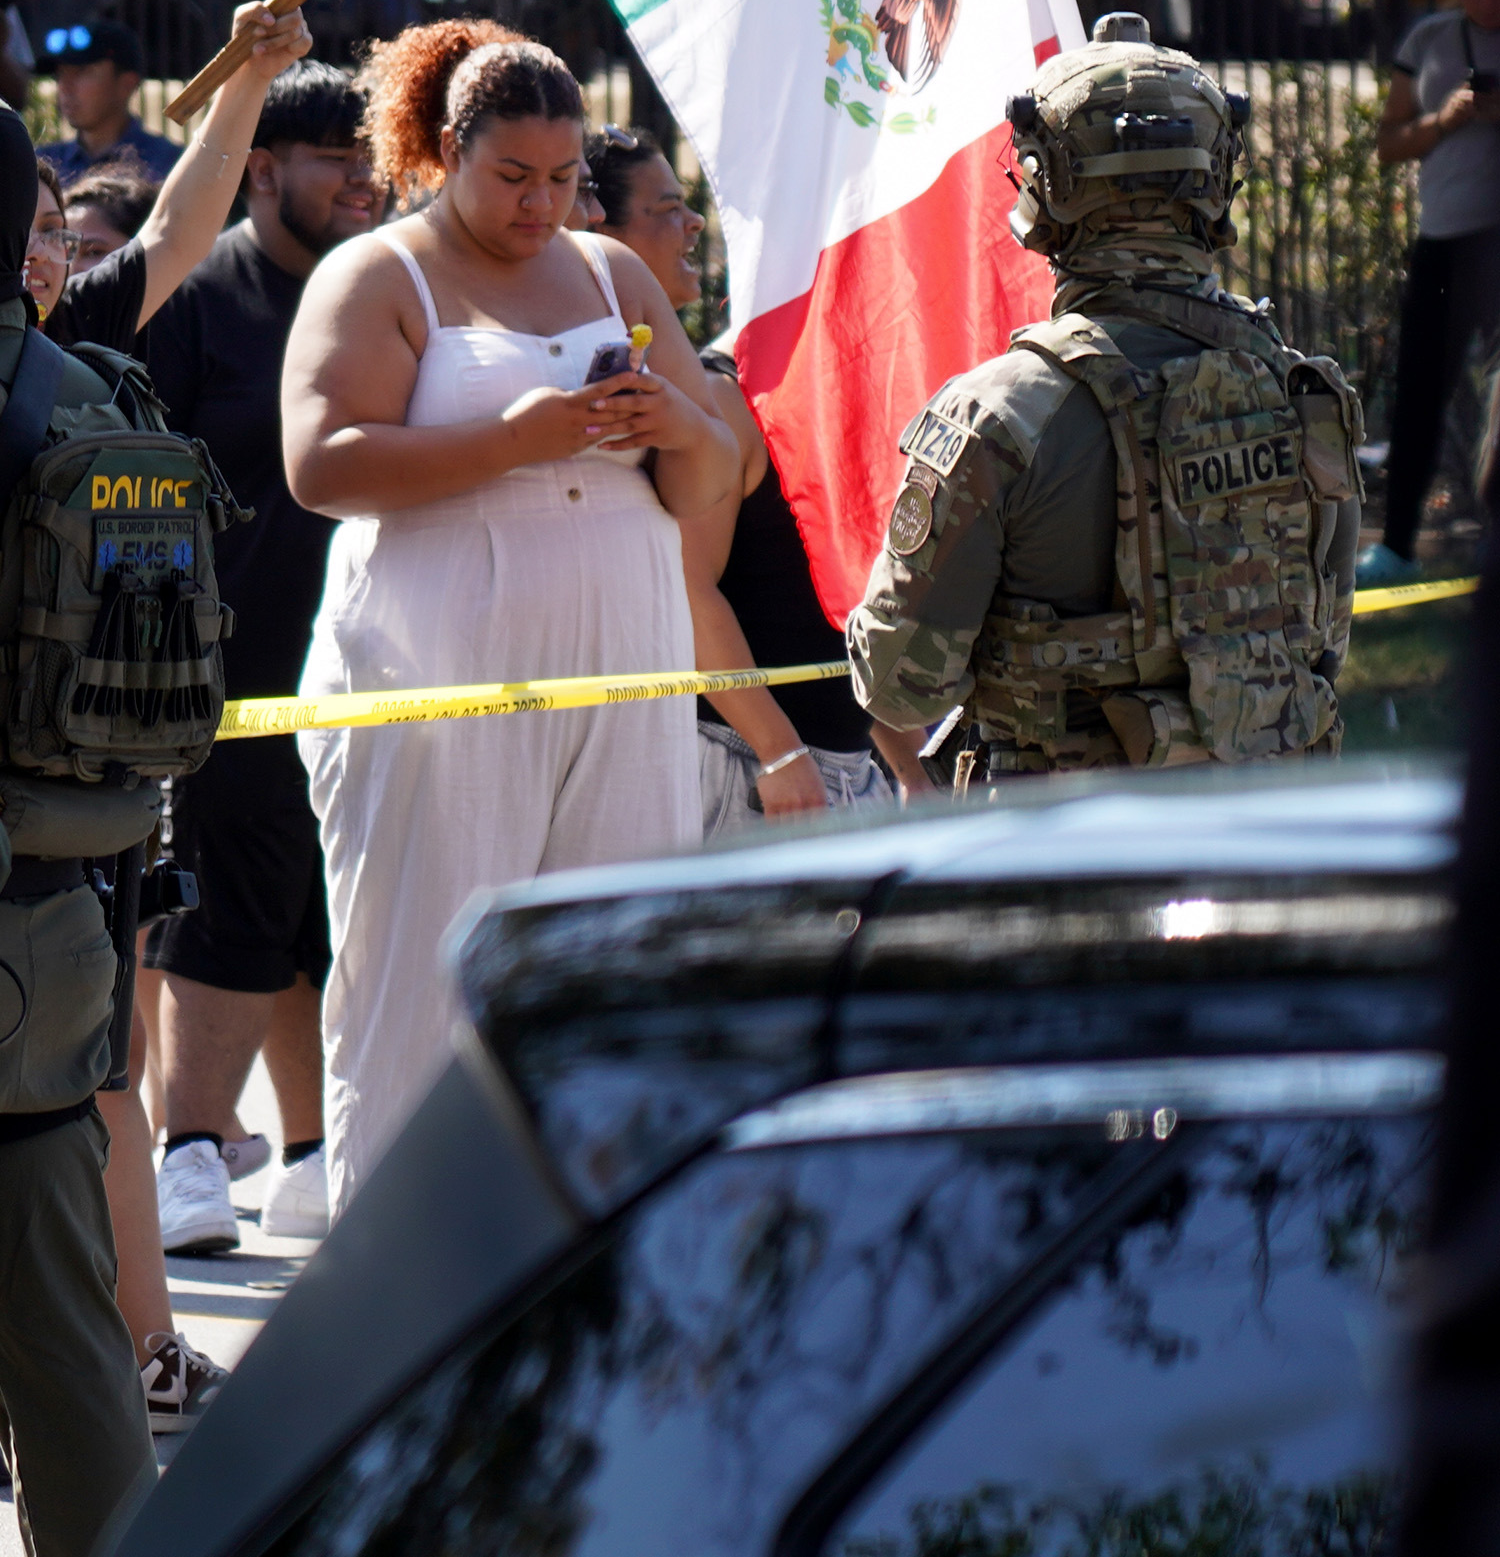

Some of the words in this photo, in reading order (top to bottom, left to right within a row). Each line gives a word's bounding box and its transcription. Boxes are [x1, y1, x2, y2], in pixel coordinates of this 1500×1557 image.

[1181, 436, 1297, 500] POLICE
[118, 521, 155, 534] BORDER
[157, 521, 193, 534] PATROL
